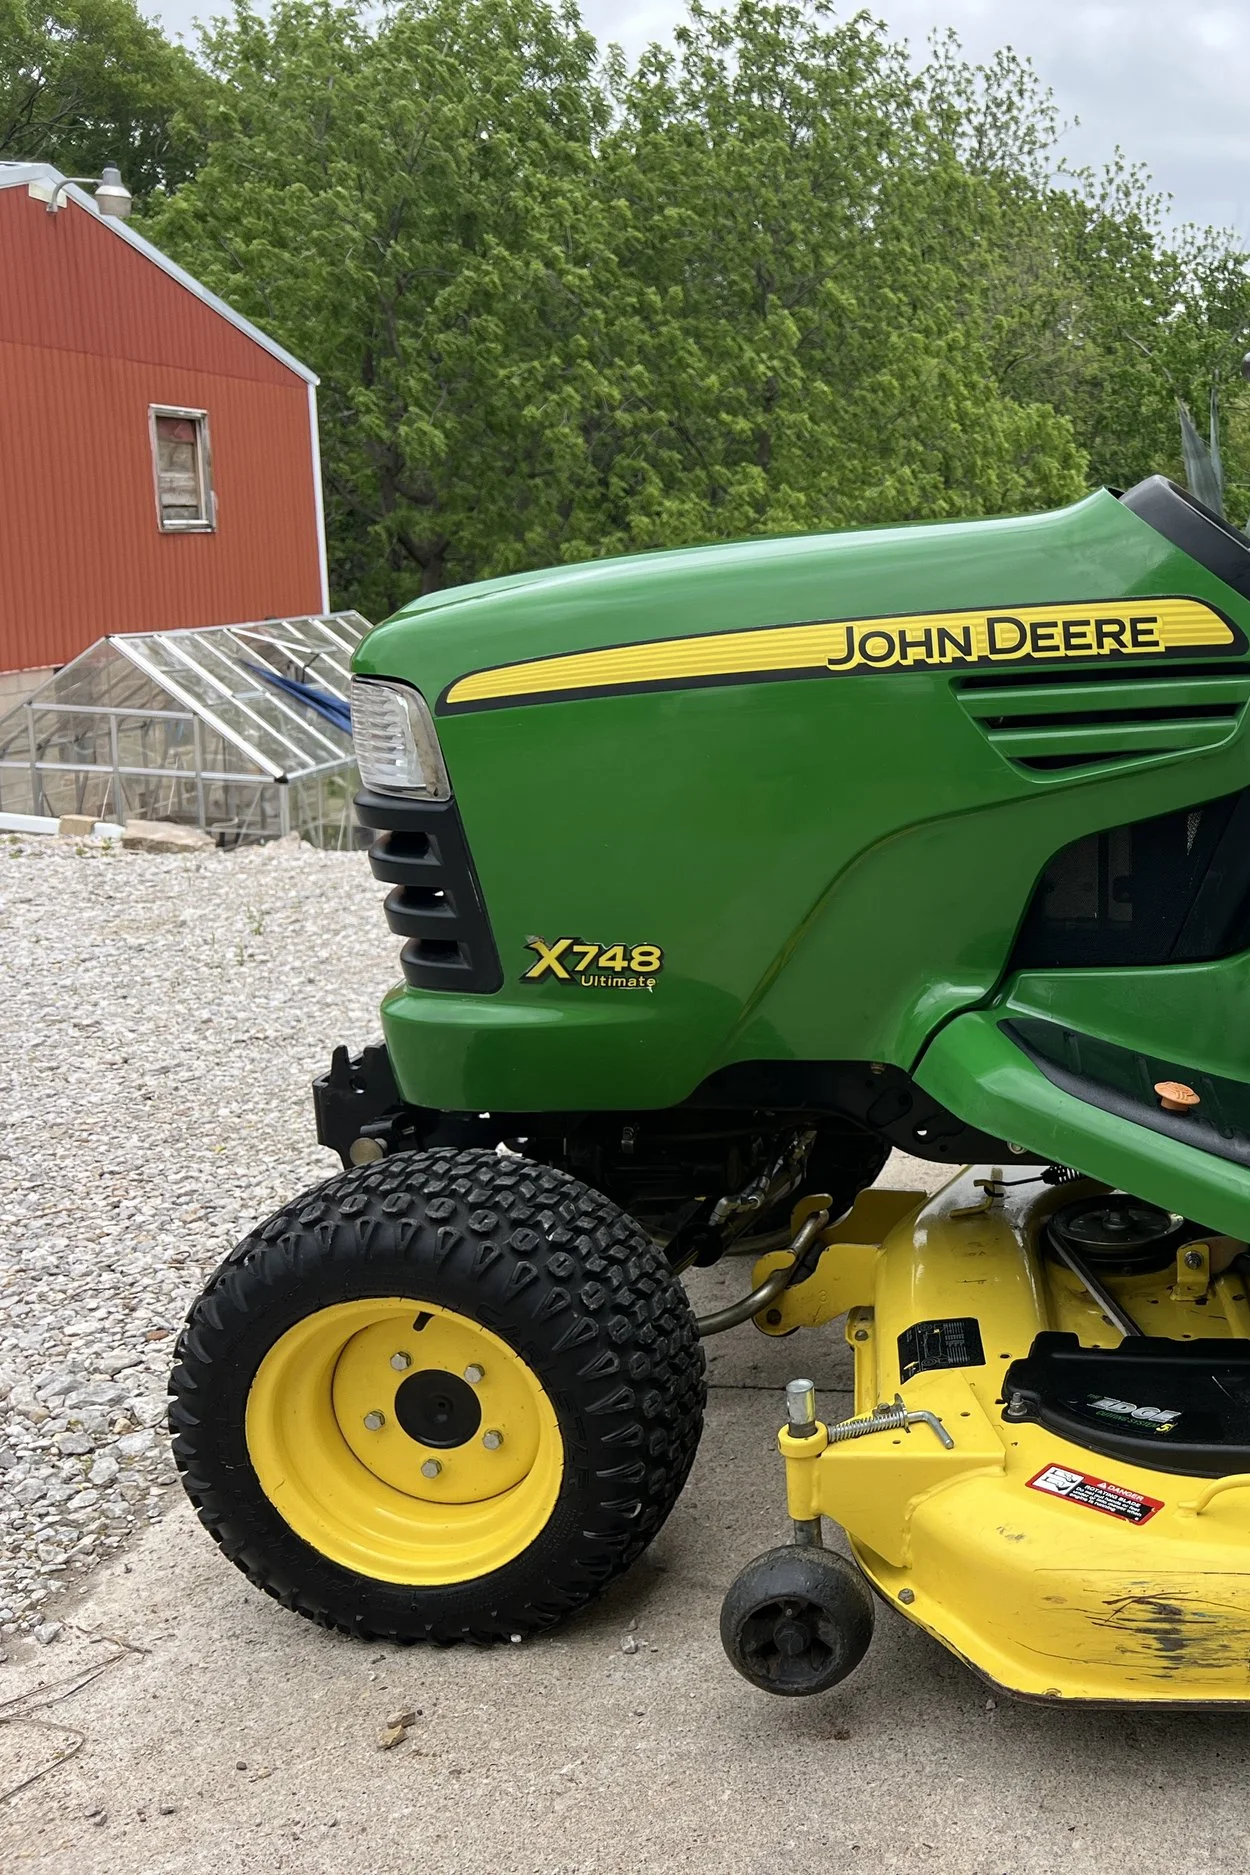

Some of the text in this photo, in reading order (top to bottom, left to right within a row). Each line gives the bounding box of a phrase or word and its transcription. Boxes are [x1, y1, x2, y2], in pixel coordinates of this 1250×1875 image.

[826, 616, 1163, 667] JOHN DEERE
[523, 937, 663, 980] X748
[580, 975, 657, 987] Ultimate
[1086, 1396, 1182, 1423] EDGE
[1084, 1485, 1141, 1507] ROTATING BLADE
[1104, 1497, 1122, 1506] hands
[1107, 1484, 1145, 1502] DANGER
